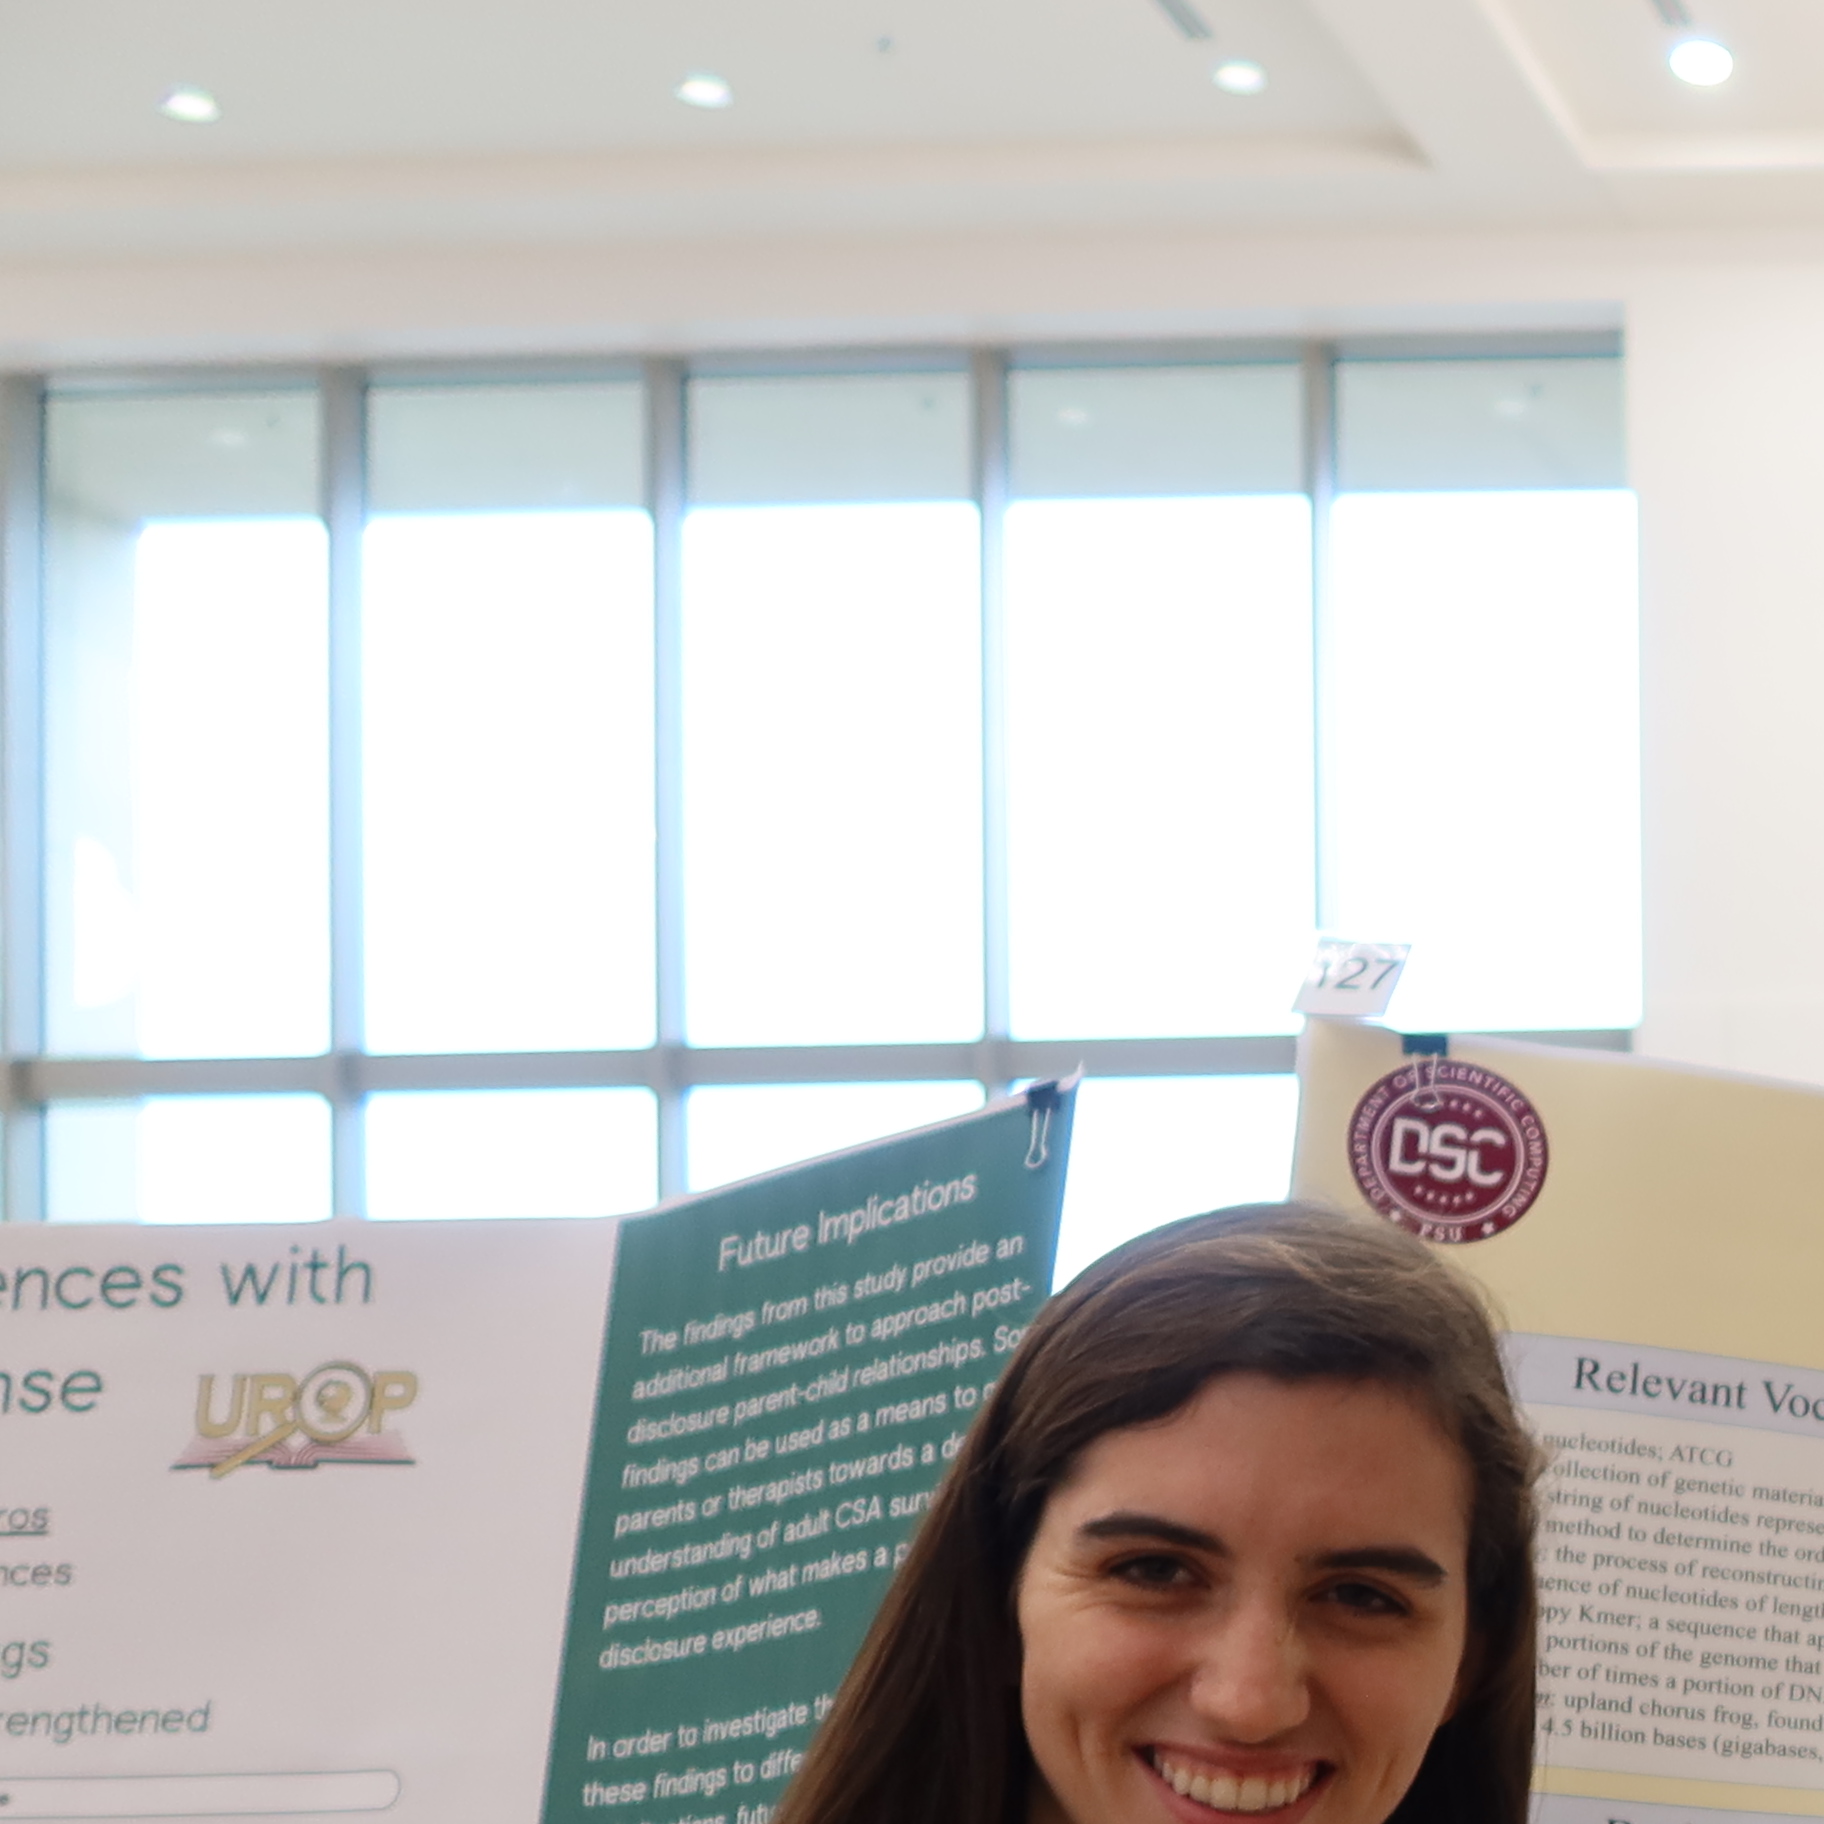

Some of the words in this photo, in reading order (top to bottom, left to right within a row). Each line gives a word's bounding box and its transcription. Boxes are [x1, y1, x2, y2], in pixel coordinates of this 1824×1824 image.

[1312, 956, 1401, 990] 127
[1352, 1086, 1391, 1204] DEPARTMENT
[1425, 1065, 1525, 1112] SCIENTIFIC
[1504, 1108, 1542, 1219] COMPUTING
[1388, 1116, 1507, 1187] DSC
[718, 1224, 810, 1272] Future
[818, 1172, 979, 1247] Implications
[1418, 1222, 1466, 1242] FSU
[0, 1263, 184, 1310] nces
[220, 1246, 372, 1306] with
[639, 1329, 678, 1355] The
[683, 1308, 756, 1345] findings
[762, 1293, 809, 1325] from
[814, 1281, 849, 1311] this
[853, 1263, 907, 1300] study
[911, 1239, 990, 1287] provide
[996, 1233, 1025, 1260] an
[631, 1356, 729, 1401] additional
[734, 1328, 840, 1373] framework
[846, 1321, 866, 1345] to
[871, 1291, 968, 1341] approach
[971, 1276, 1031, 1317] post-
[196, 1360, 416, 1445] UROP
[1573, 1357, 1748, 1411] Relevant
[599, 1633, 708, 1671] disclosure
[712, 1607, 822, 1651] experience.
[0, 1700, 211, 1744] engthened
